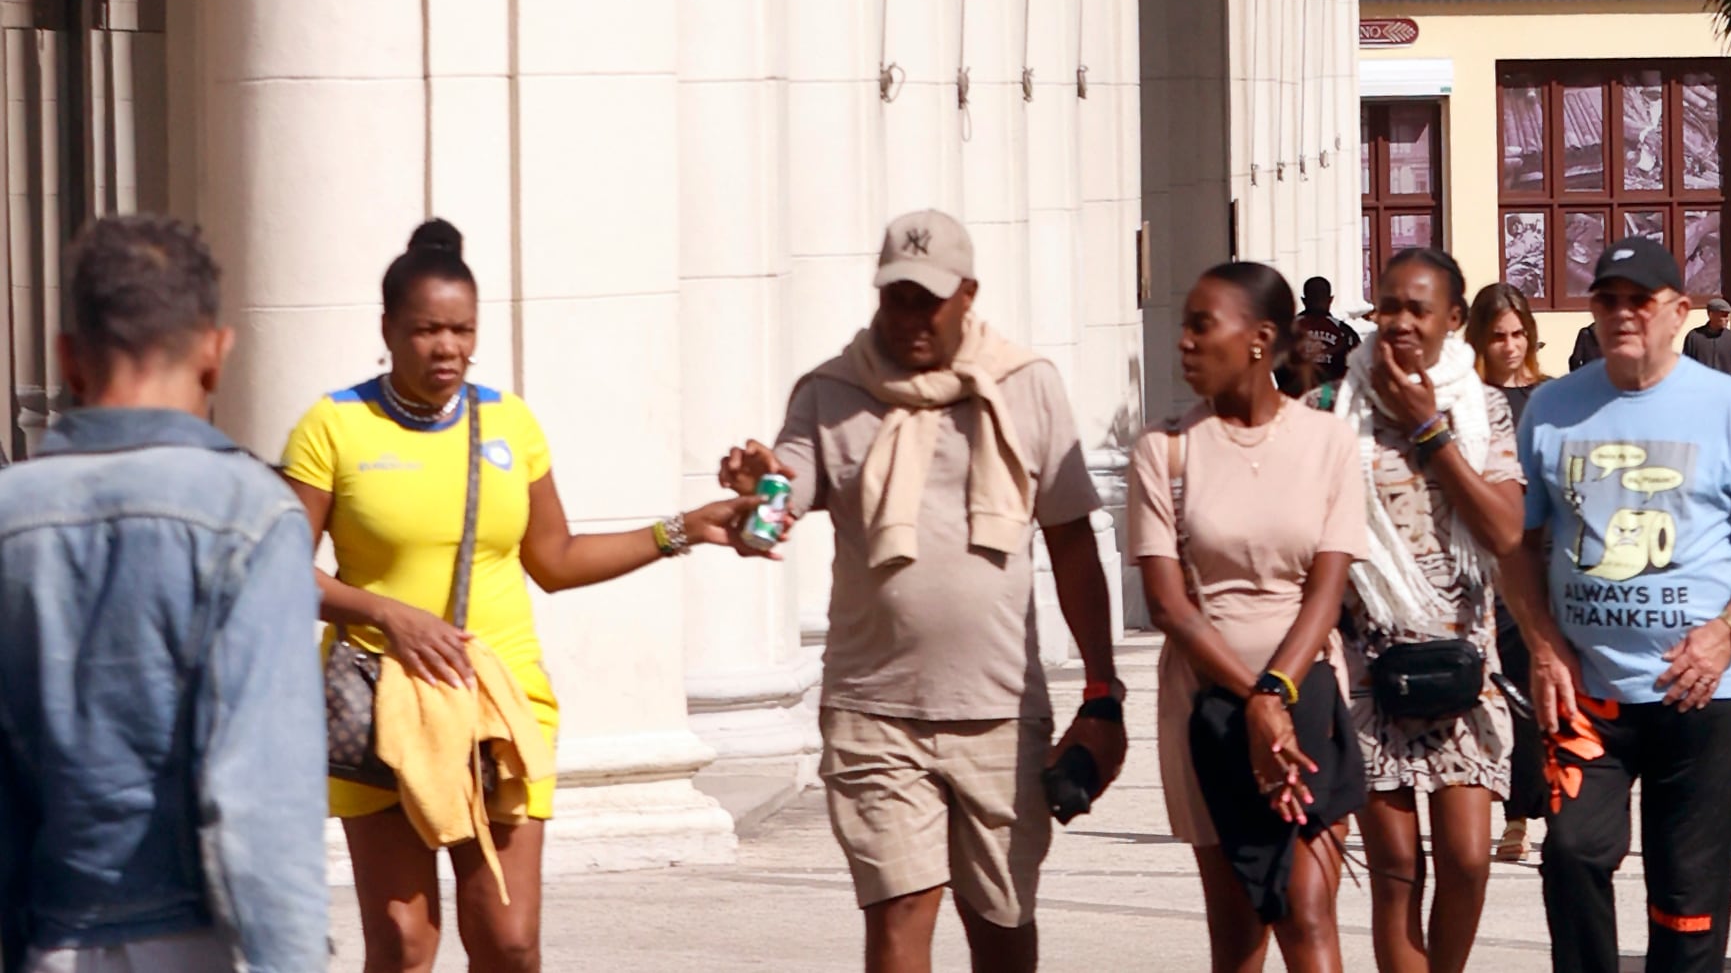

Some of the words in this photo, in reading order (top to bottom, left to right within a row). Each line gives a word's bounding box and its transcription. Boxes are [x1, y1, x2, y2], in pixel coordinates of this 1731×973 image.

[1564, 584, 1649, 604] ALWAYS
[1661, 587, 1688, 604] BE
[1565, 604, 1693, 628] THANKFUL
